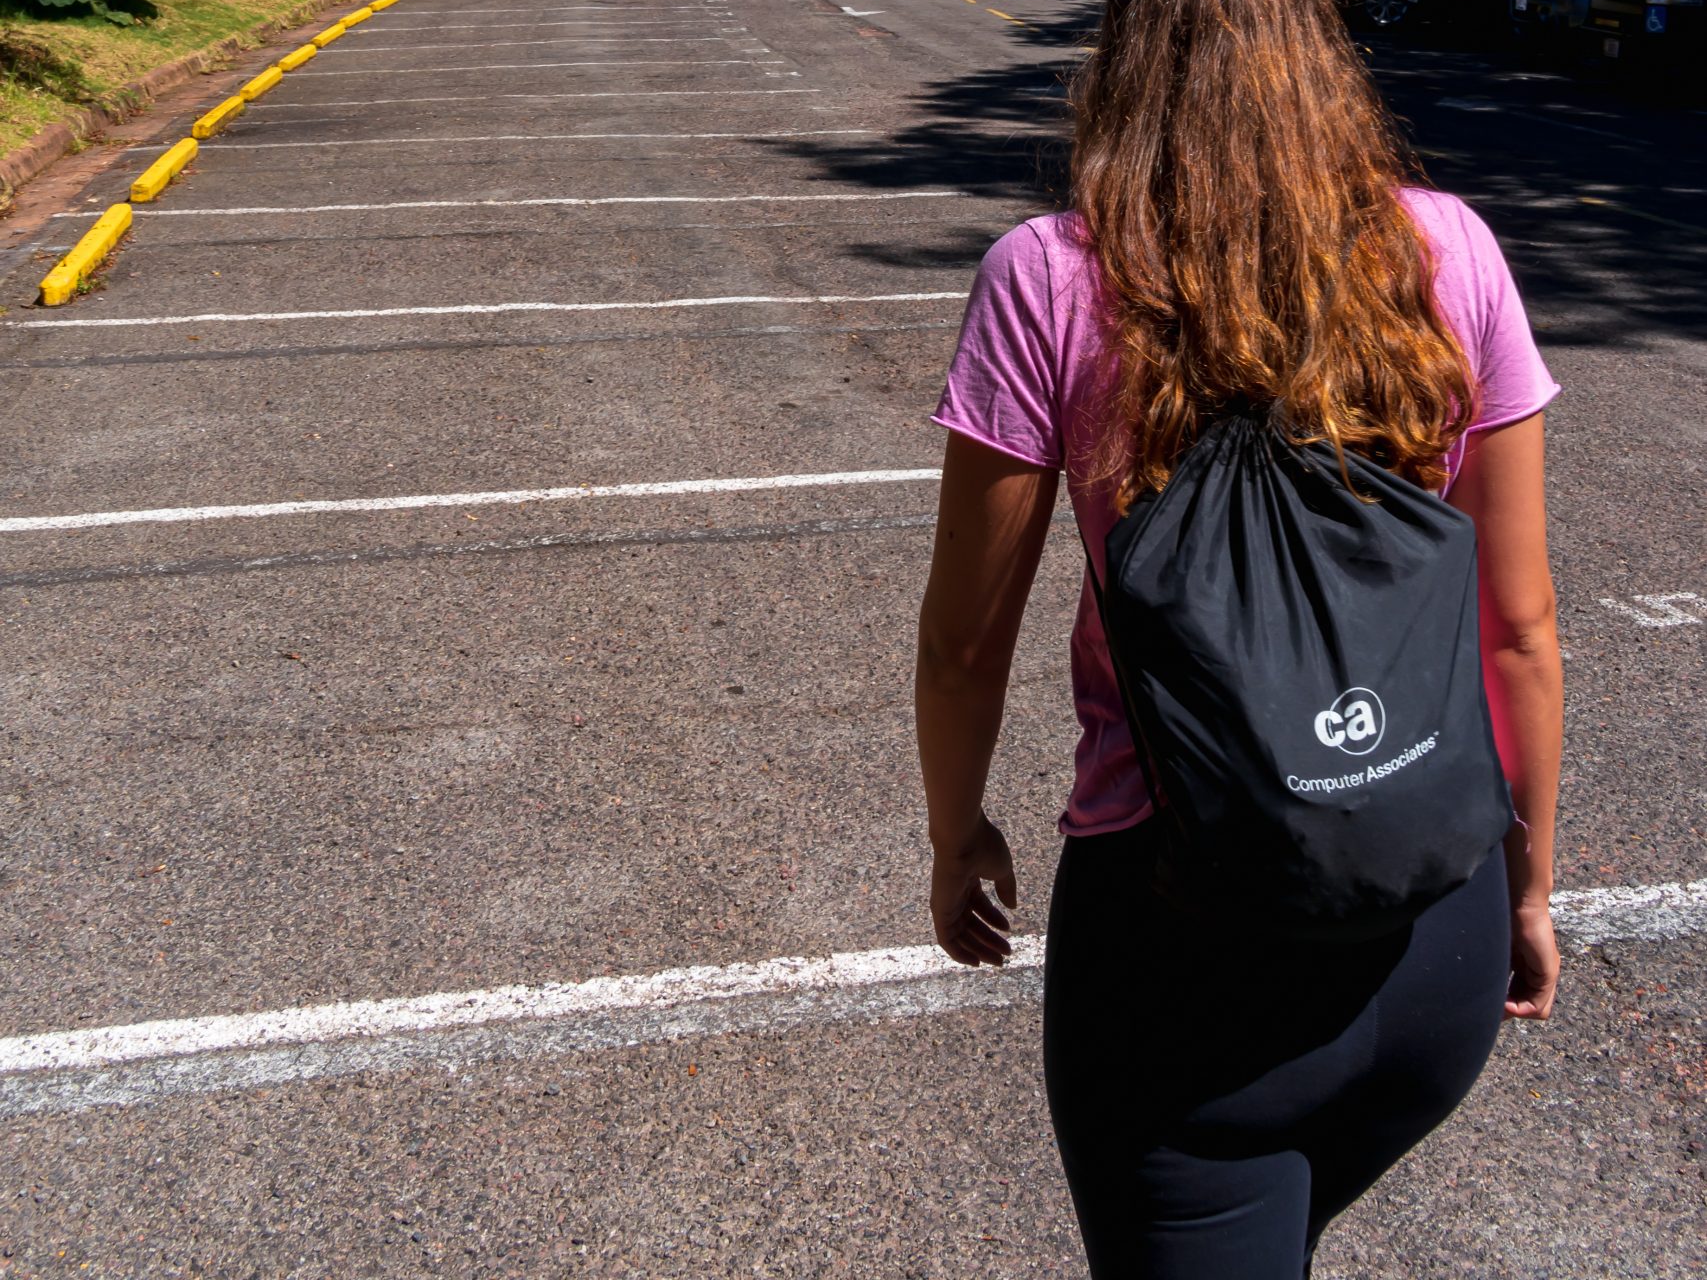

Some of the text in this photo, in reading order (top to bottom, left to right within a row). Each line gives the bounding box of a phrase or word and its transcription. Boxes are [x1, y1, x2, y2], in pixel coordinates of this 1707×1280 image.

[1314, 700, 1377, 747] ca
[1286, 735, 1437, 793] Computer Associates
